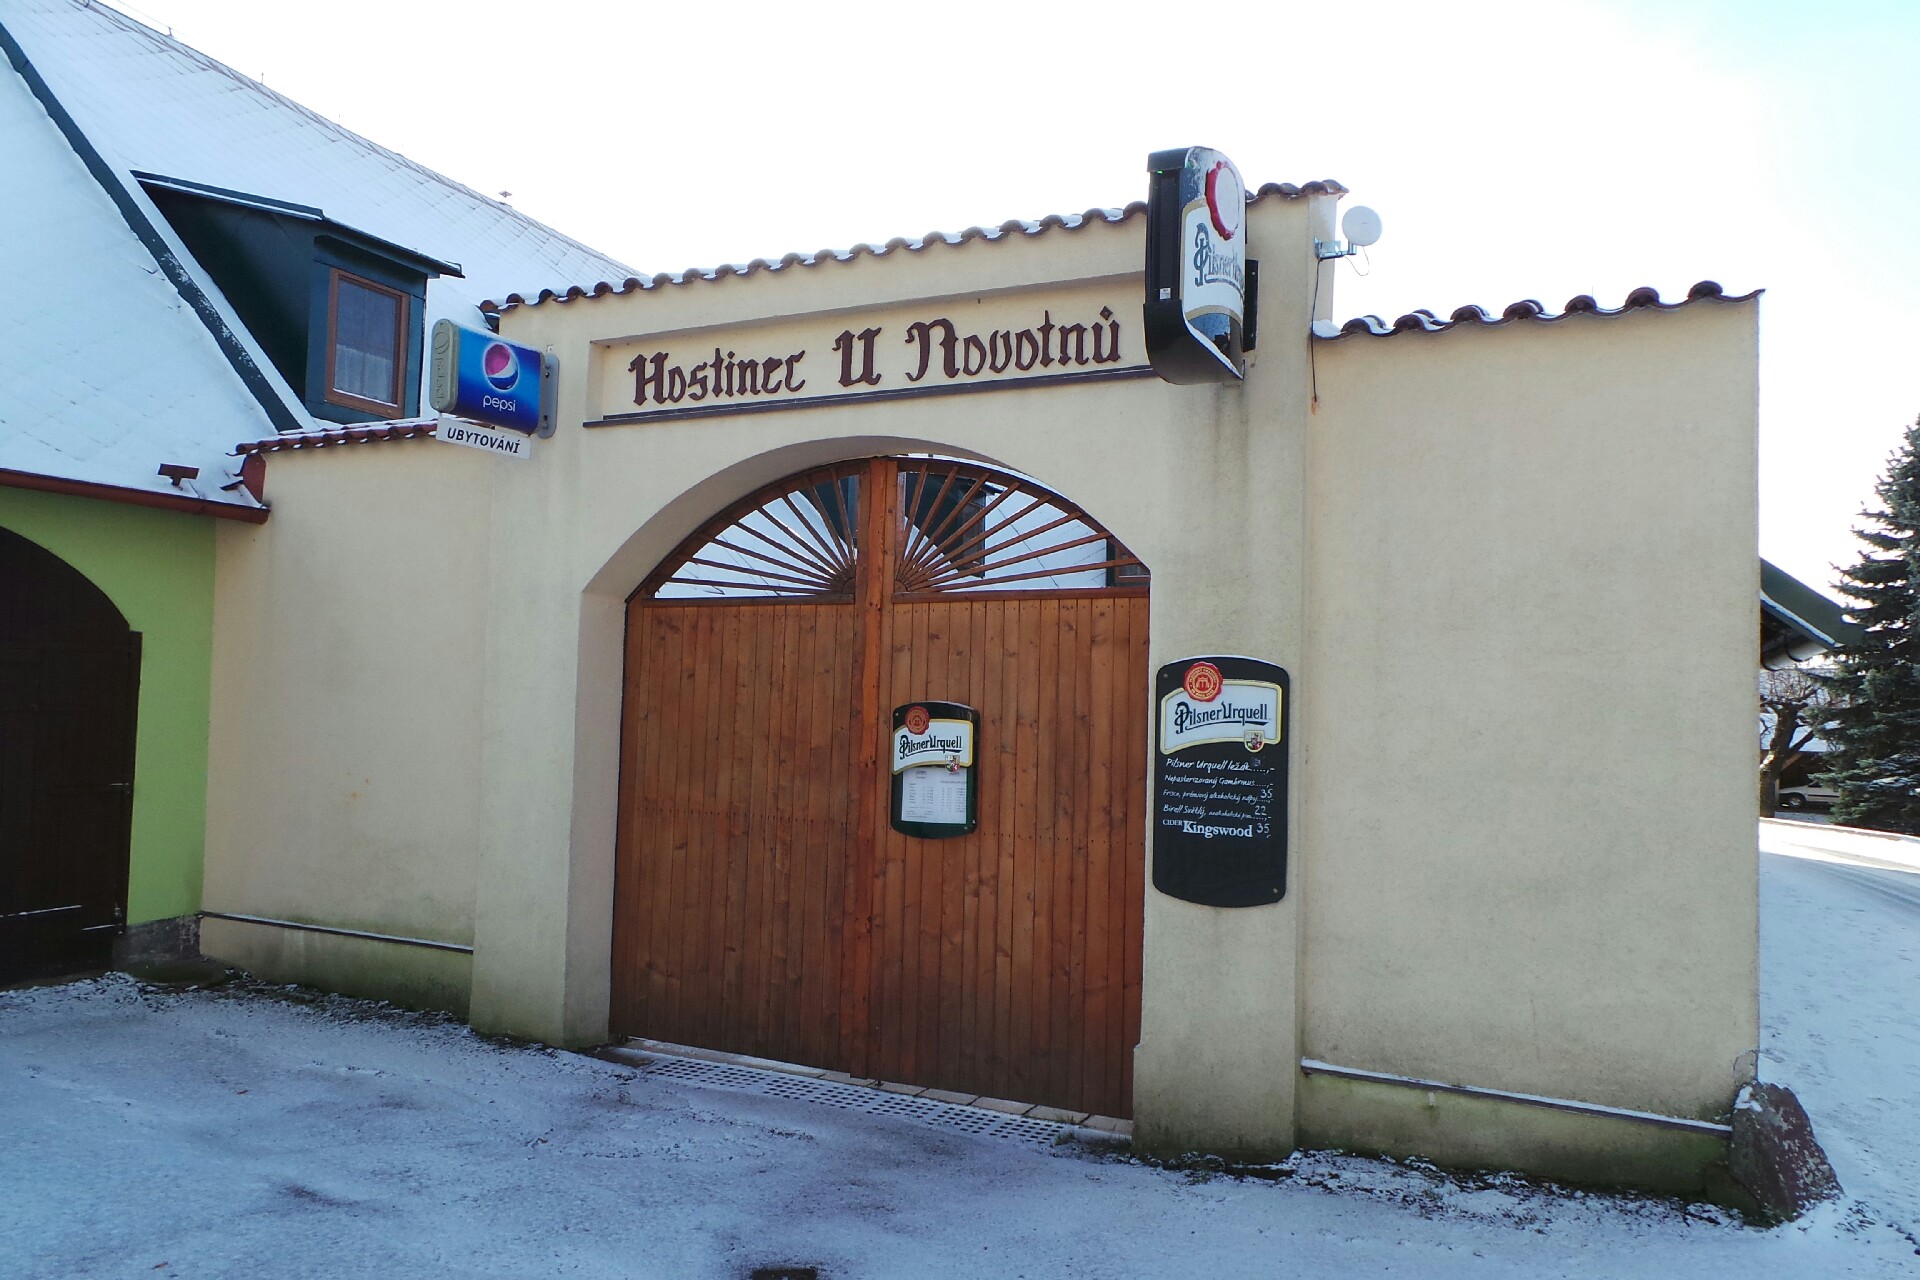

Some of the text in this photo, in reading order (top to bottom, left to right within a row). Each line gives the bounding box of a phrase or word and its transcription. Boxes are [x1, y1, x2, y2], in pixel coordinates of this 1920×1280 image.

[628, 348, 806, 406] Hostinec
[832, 327, 882, 387] U
[482, 395, 516, 412] pepsi
[447, 427, 521, 454] UBYTOVÁNÍ
[1174, 701, 1267, 734] Pilsner Urquell
[899, 734, 962, 760] Pilsner Urquell
[1166, 757, 1195, 768] Pilsner
[1196, 760, 1227, 773] Urquell
[1183, 820, 1253, 838] Kingswood
